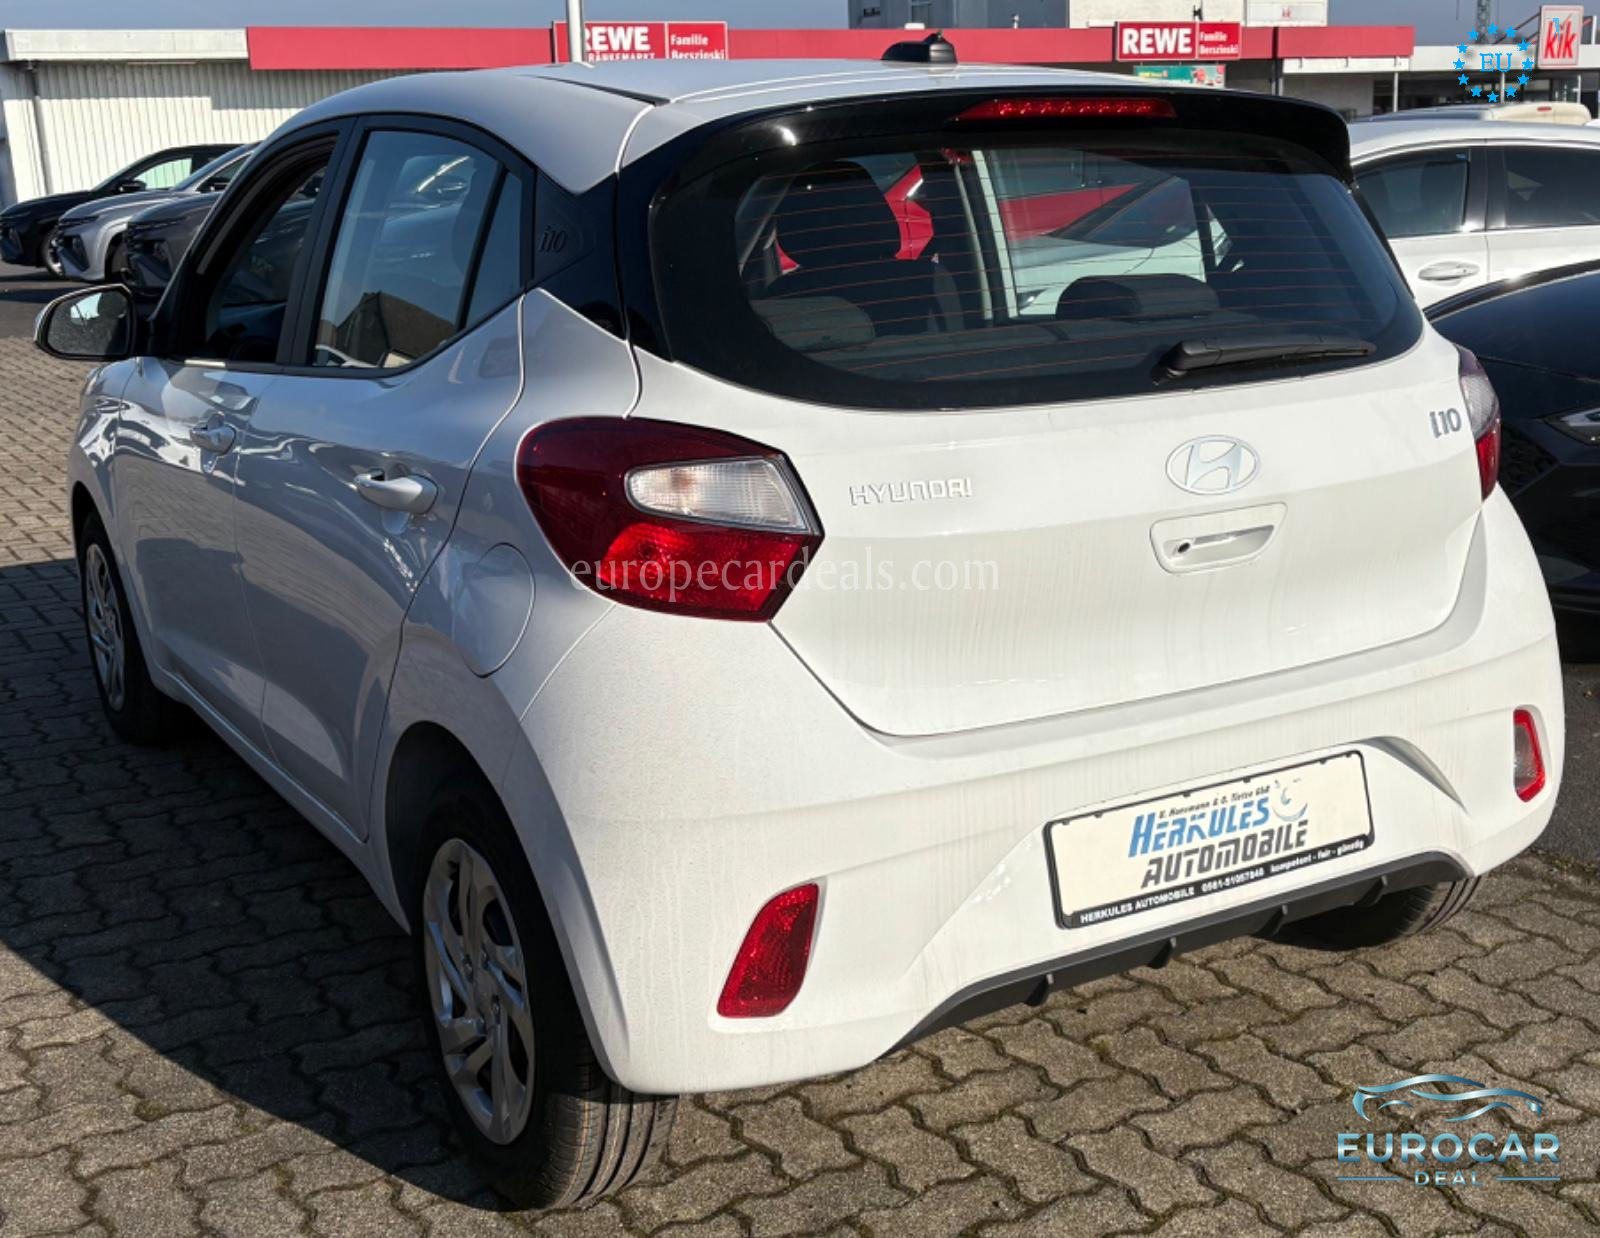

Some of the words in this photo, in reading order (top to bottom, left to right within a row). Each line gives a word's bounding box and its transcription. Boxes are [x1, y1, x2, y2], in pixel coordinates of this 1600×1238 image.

[670, 34, 709, 46] Familie
[1122, 28, 1193, 54] REWE
[539, 225, 567, 253] i10
[849, 477, 973, 506] HYUNDAI
[1128, 796, 1270, 858] HERKULES
[1141, 820, 1309, 889] AUTOMOBILE
[1080, 902, 1134, 924] HERKULES
[1135, 886, 1195, 910] AUTOMOBILE
